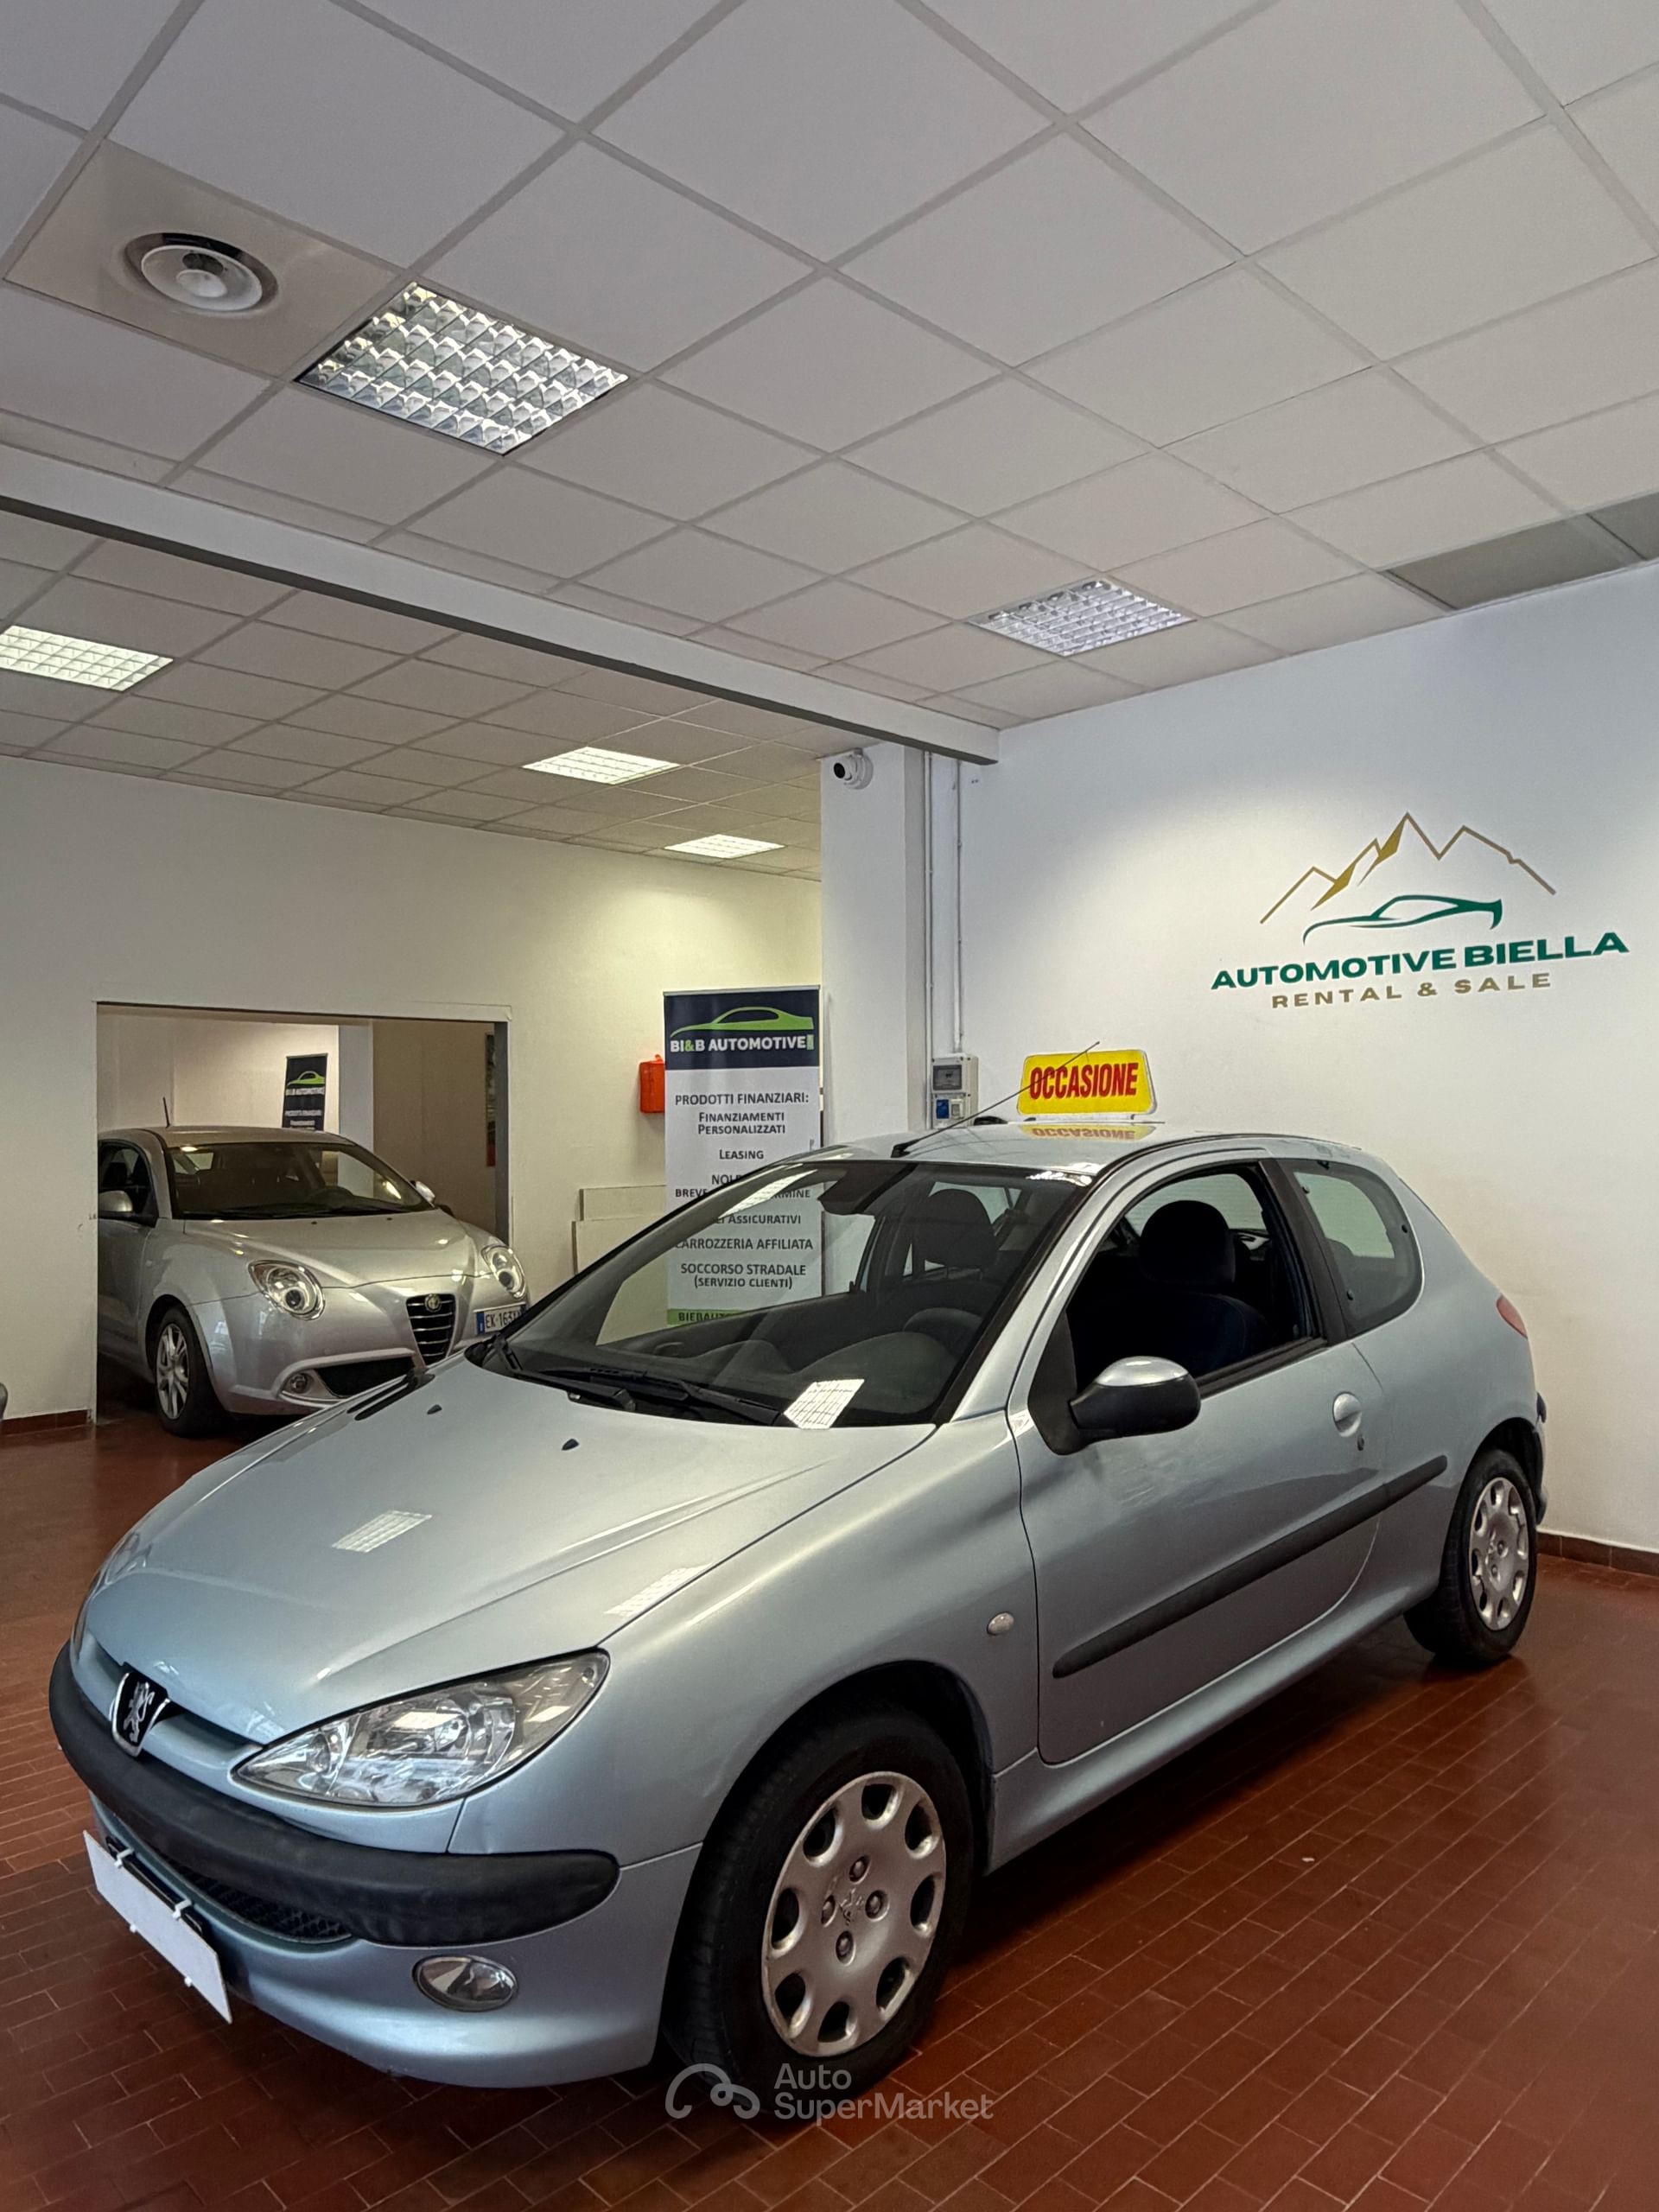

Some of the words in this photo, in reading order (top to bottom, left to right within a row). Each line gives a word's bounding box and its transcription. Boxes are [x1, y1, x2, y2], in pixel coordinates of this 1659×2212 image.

[1211, 948, 1457, 989] AUTOMOTIVE
[1464, 931, 1630, 968] BIELLA
[1271, 985, 1402, 1009] RENTAL
[1416, 982, 1438, 997] &
[1454, 972, 1552, 995] SALE
[670, 1039, 706, 1052] BI&B
[709, 1036, 806, 1052] AUTOMOTIVE
[1029, 1062, 1139, 1100] OCCASIONE
[675, 1094, 734, 1106] PRODOTTI
[737, 1092, 810, 1105] FINANZIARI:
[698, 1111, 785, 1122] FINANZIAMENTI
[698, 1123, 785, 1135] PERSONALIZZATI
[719, 1149, 764, 1160] LEASING
[728, 1214, 801, 1224] ASSICURATIVI
[756, 1238, 814, 1249] AFFILIATA
[680, 1262, 744, 1274] SOCCORSO
[747, 1264, 806, 1276] STRADALE
[694, 1274, 746, 1289] (SERVIZIO
[749, 1276, 793, 1290] CLIENTI)
